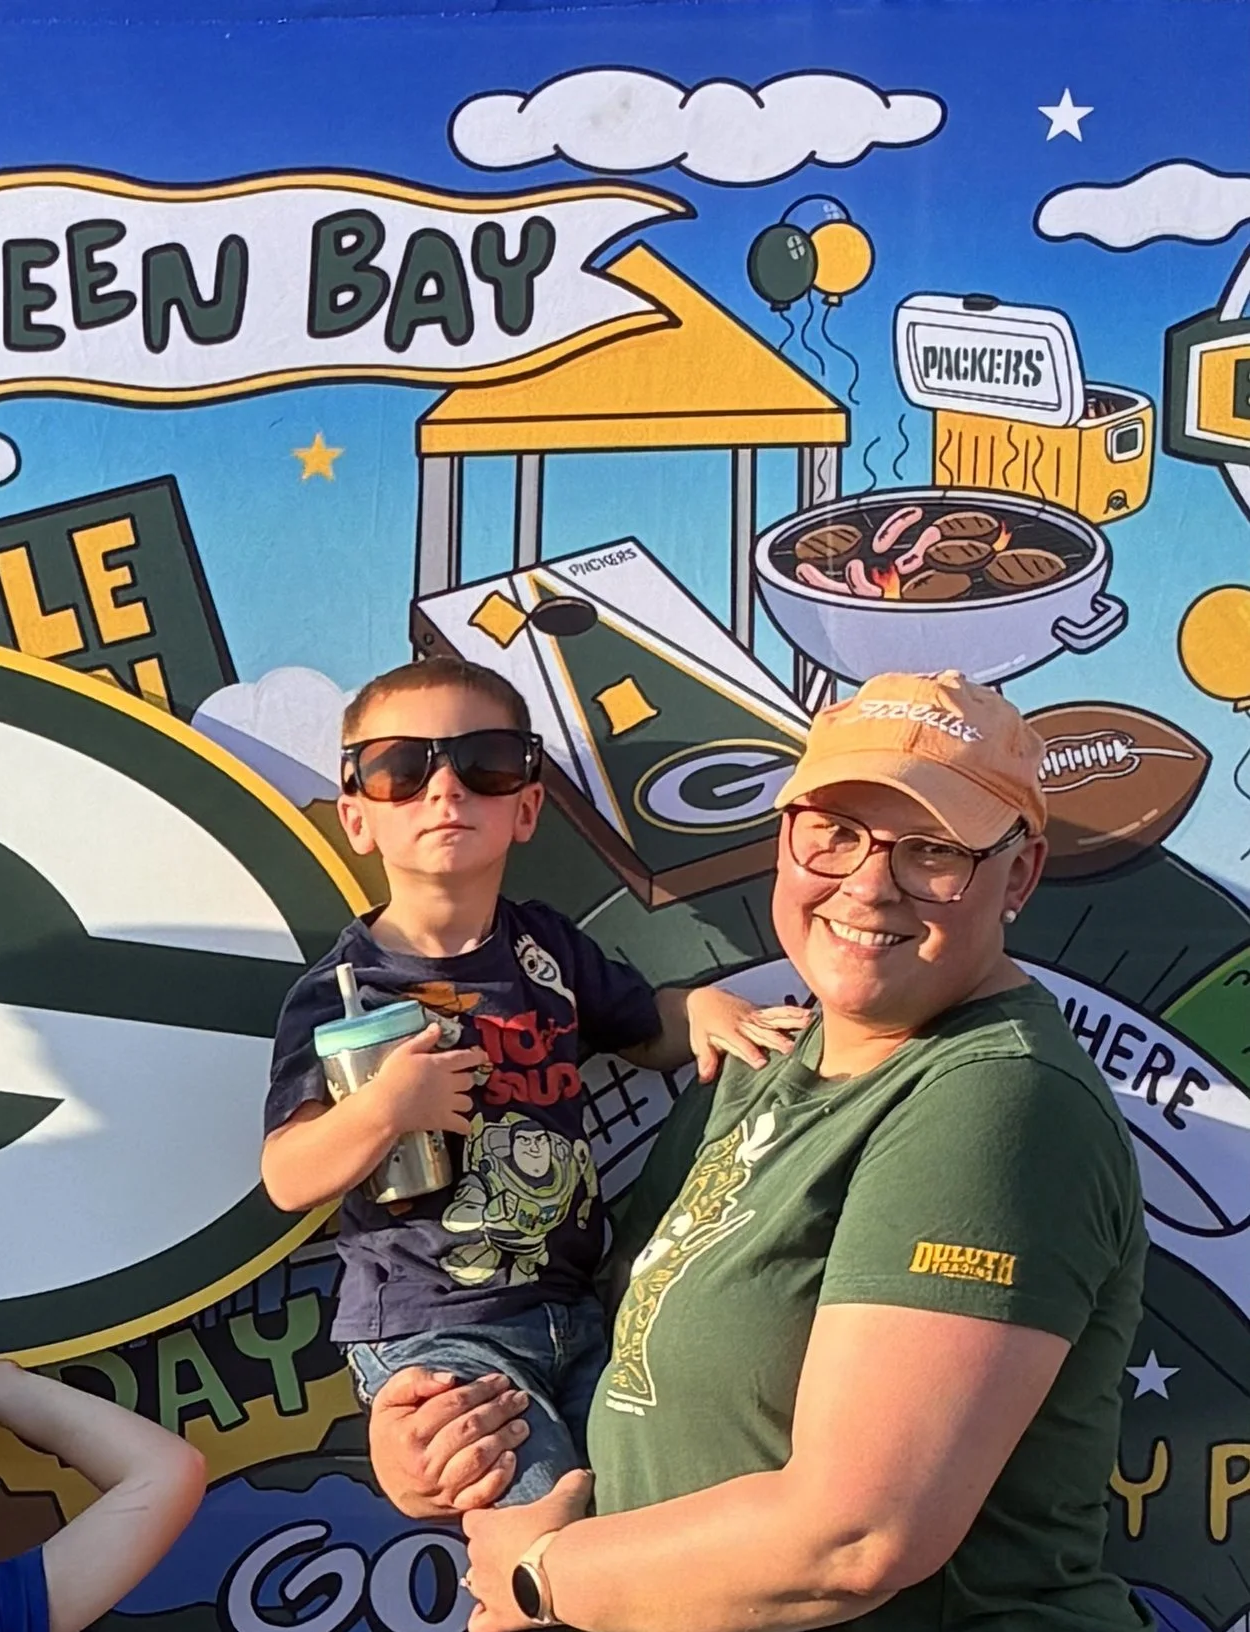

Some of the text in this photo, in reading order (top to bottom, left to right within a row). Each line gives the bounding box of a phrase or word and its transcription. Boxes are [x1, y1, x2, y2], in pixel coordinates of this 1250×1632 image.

[306, 208, 557, 353] BAY
[922, 345, 1045, 388] PACKERS
[908, 1241, 1017, 1285] DULUTH
